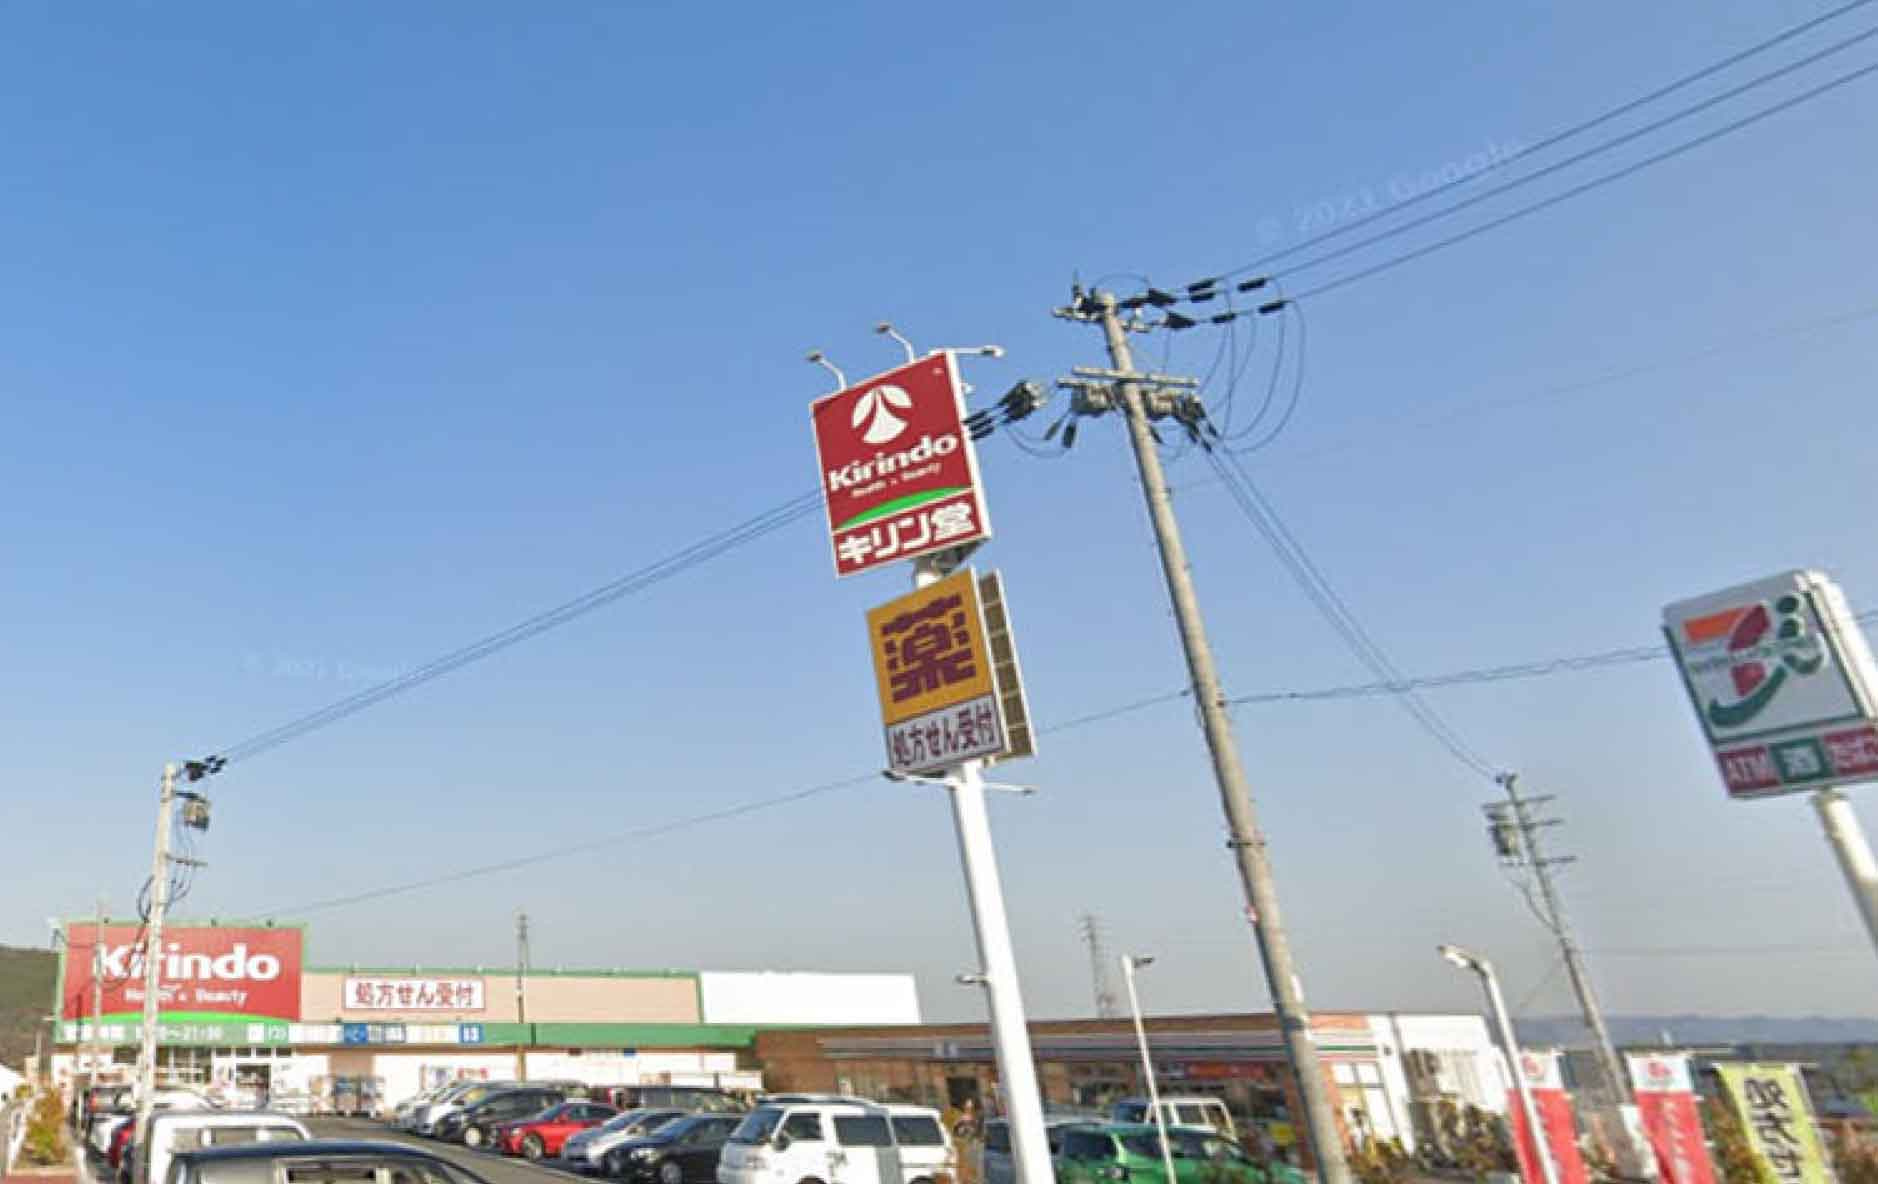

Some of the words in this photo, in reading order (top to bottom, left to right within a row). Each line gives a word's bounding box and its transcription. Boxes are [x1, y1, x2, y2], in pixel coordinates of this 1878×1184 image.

[829, 434, 958, 492] Kirindo
[839, 502, 974, 564] キリン堂
[893, 703, 994, 766] 処方せん受付
[355, 982, 475, 1008] 処方せん受付
